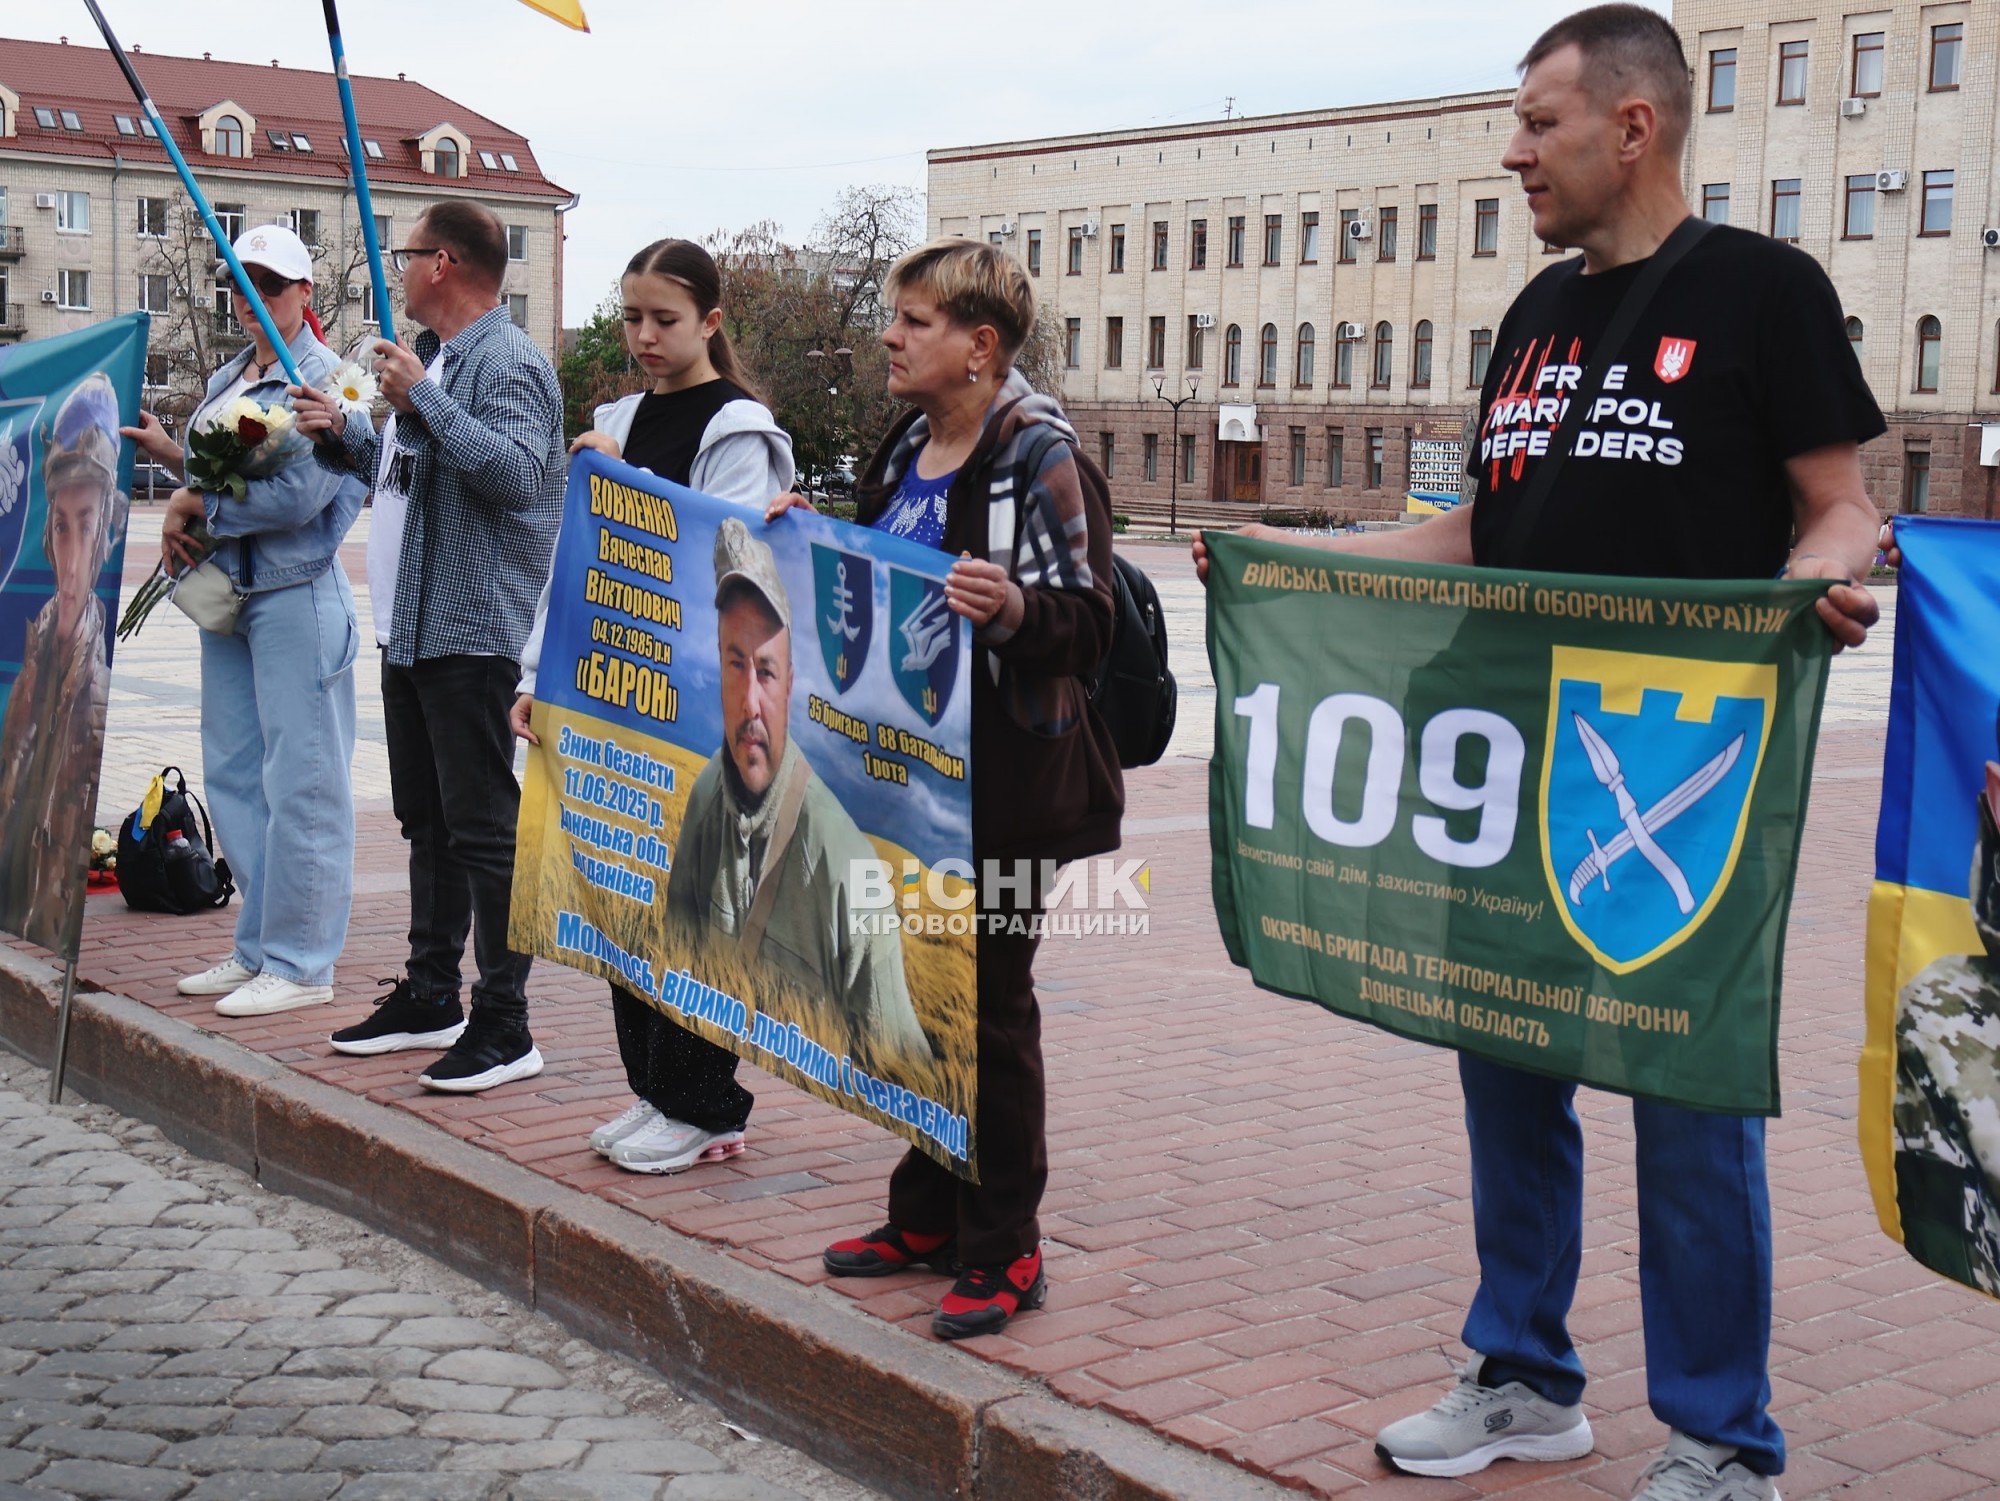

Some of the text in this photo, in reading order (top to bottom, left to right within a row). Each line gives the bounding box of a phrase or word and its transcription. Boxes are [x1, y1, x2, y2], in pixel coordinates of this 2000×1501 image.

[1535, 364, 1628, 391] FRE
[1490, 397, 1674, 430] MARIPOL
[1481, 430, 1684, 466] DEFEDERS
[590, 474, 678, 542] ВОВНЕНКО
[598, 526, 673, 584] Вячеслав
[585, 567, 681, 631] Вікторович
[1241, 561, 1790, 634] ВІЙСЬКА ТЕРИТОРІАЛЬНОЇ ОБОРОНИ УКРАЇНИ
[591, 616, 654, 659] 04.12.1985
[558, 725, 675, 793] Зник безвісти
[808, 694, 965, 781] 35 бригада 88 батальйон
[863, 751, 908, 787] 1 рота
[564, 766, 664, 829] 11.06.2025 р.
[1234, 682, 1525, 868] 109
[636, 834, 670, 872] обл.
[1306, 858, 1335, 878] свій
[1338, 864, 1371, 887] дім,
[1376, 872, 1467, 903] захистимо
[1471, 886, 1544, 923] Україну!
[1261, 915, 1690, 1036] ОКРЕМА БРИГАДА ТЕРИТОРІАЛЬНОЇ ОБОРОНИ
[556, 910, 968, 1161] Молимось, віримо, любимо і чекаємо!
[1360, 976, 1551, 1048] ДОНЕЦЬКА ОБЛАСТЬ
